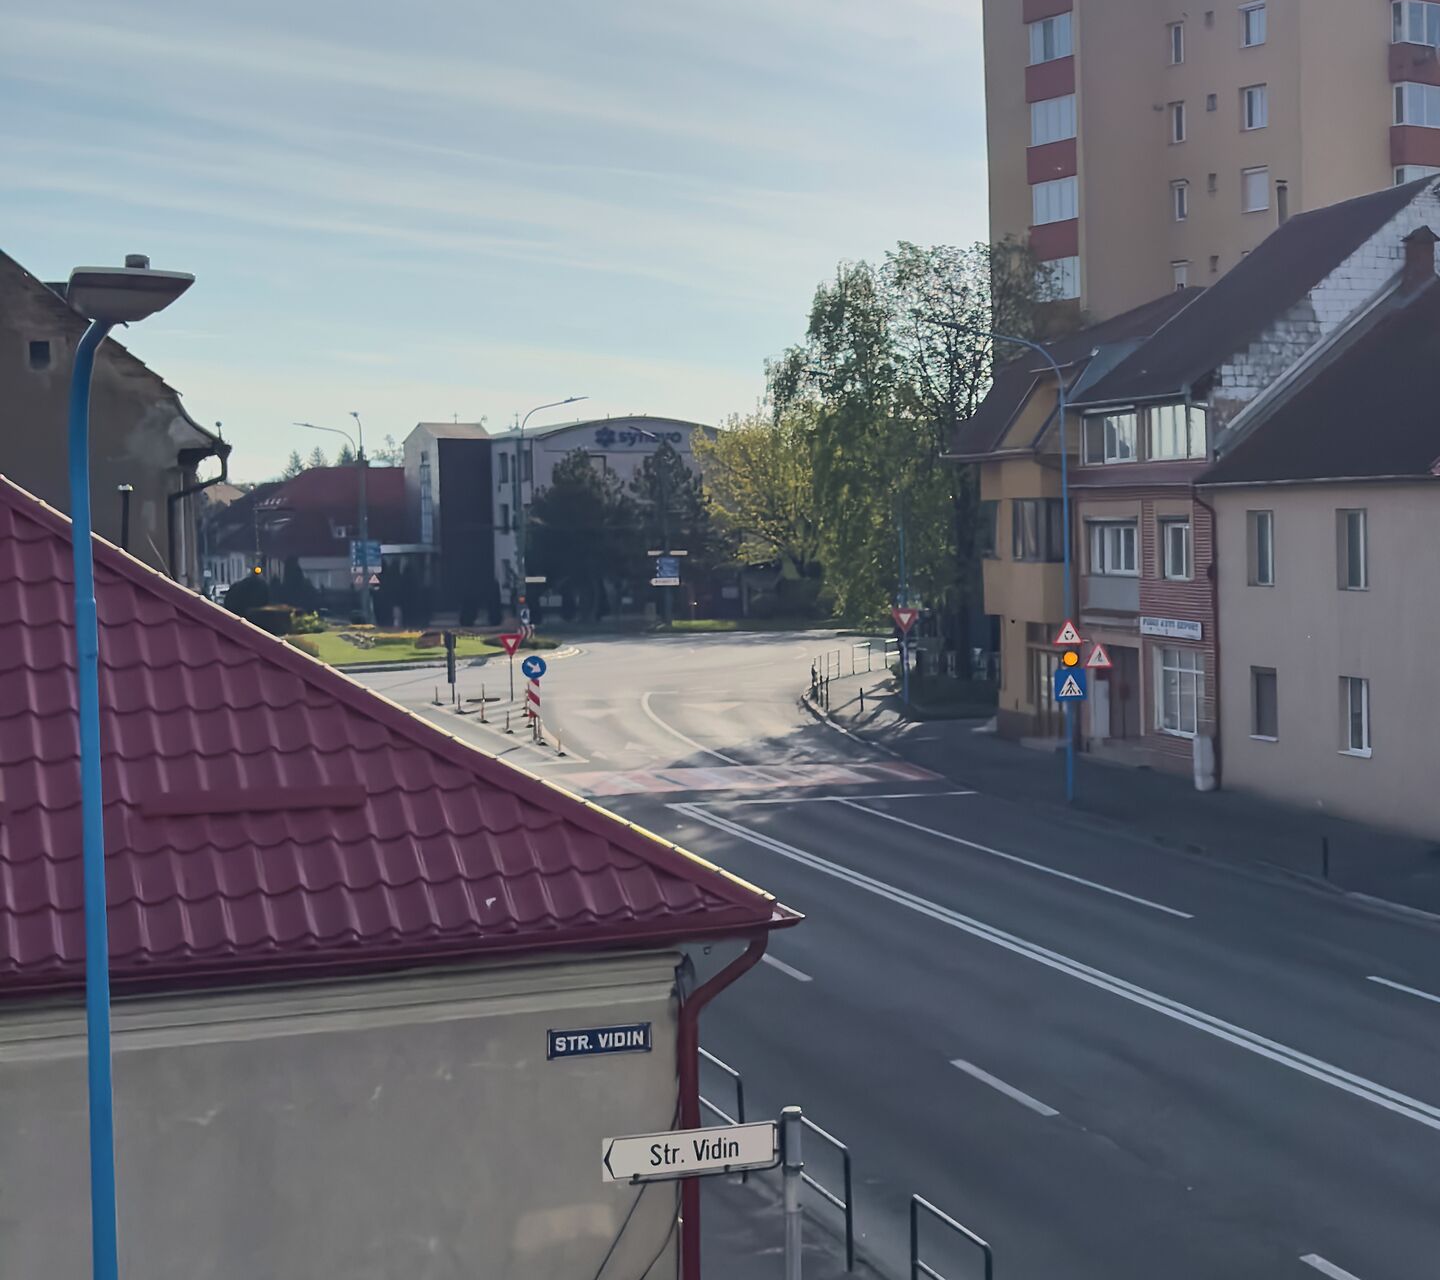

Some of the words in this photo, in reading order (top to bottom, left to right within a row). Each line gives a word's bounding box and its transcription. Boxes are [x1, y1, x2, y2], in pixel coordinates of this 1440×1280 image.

[555, 1035, 593, 1052] STR.
[598, 1030, 644, 1048] VIDIN
[650, 1143, 685, 1166] Str.
[693, 1137, 739, 1161] Vidin
